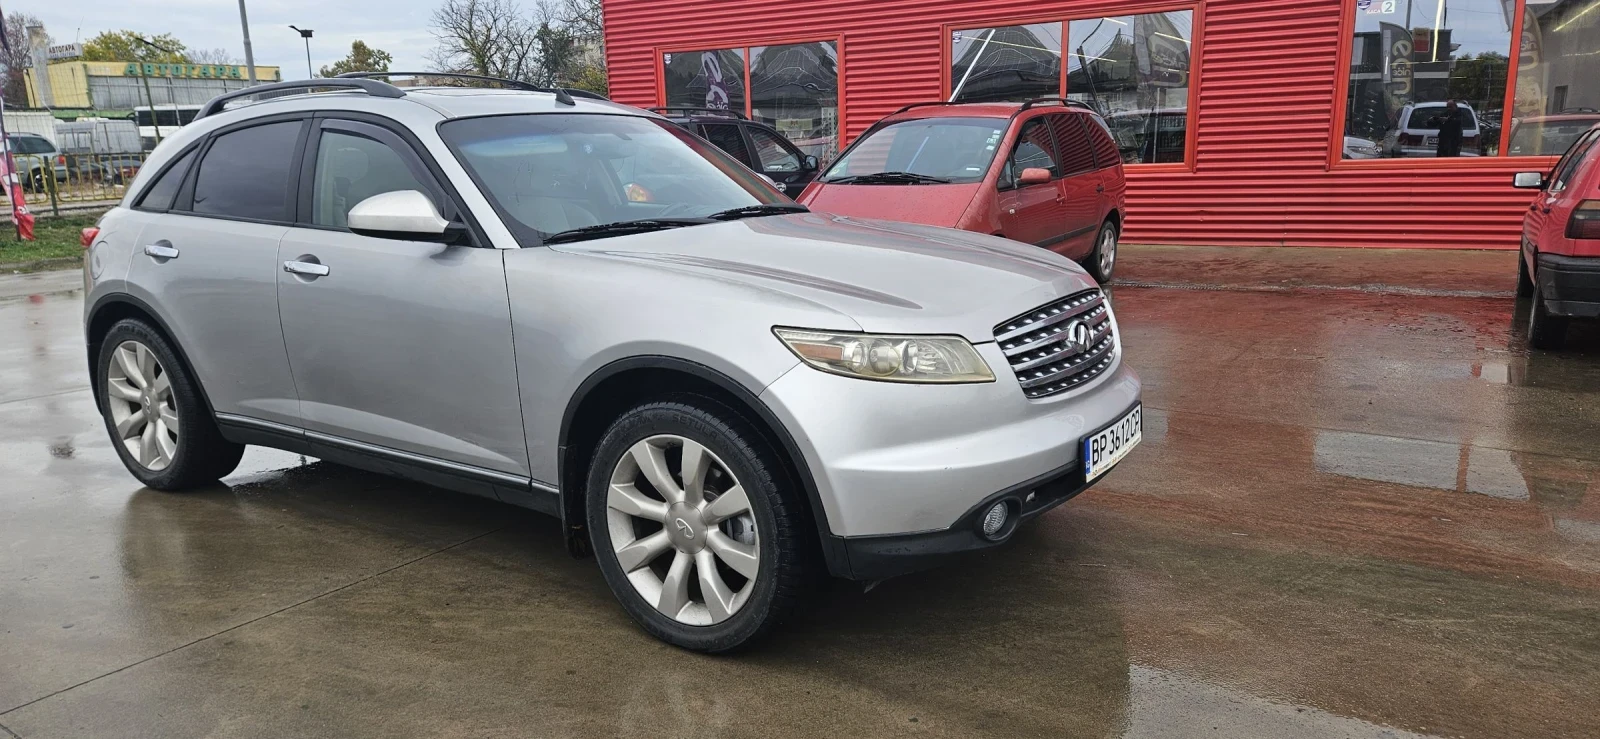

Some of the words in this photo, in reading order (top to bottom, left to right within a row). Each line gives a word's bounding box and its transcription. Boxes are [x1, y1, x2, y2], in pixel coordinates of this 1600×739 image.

[1384, 1, 1393, 13] 2
[48, 44, 76, 54] АВТОГАРА
[124, 63, 242, 78] АВТОГАРА
[1092, 434, 1107, 466] BP
[1109, 418, 1130, 455] 3612
